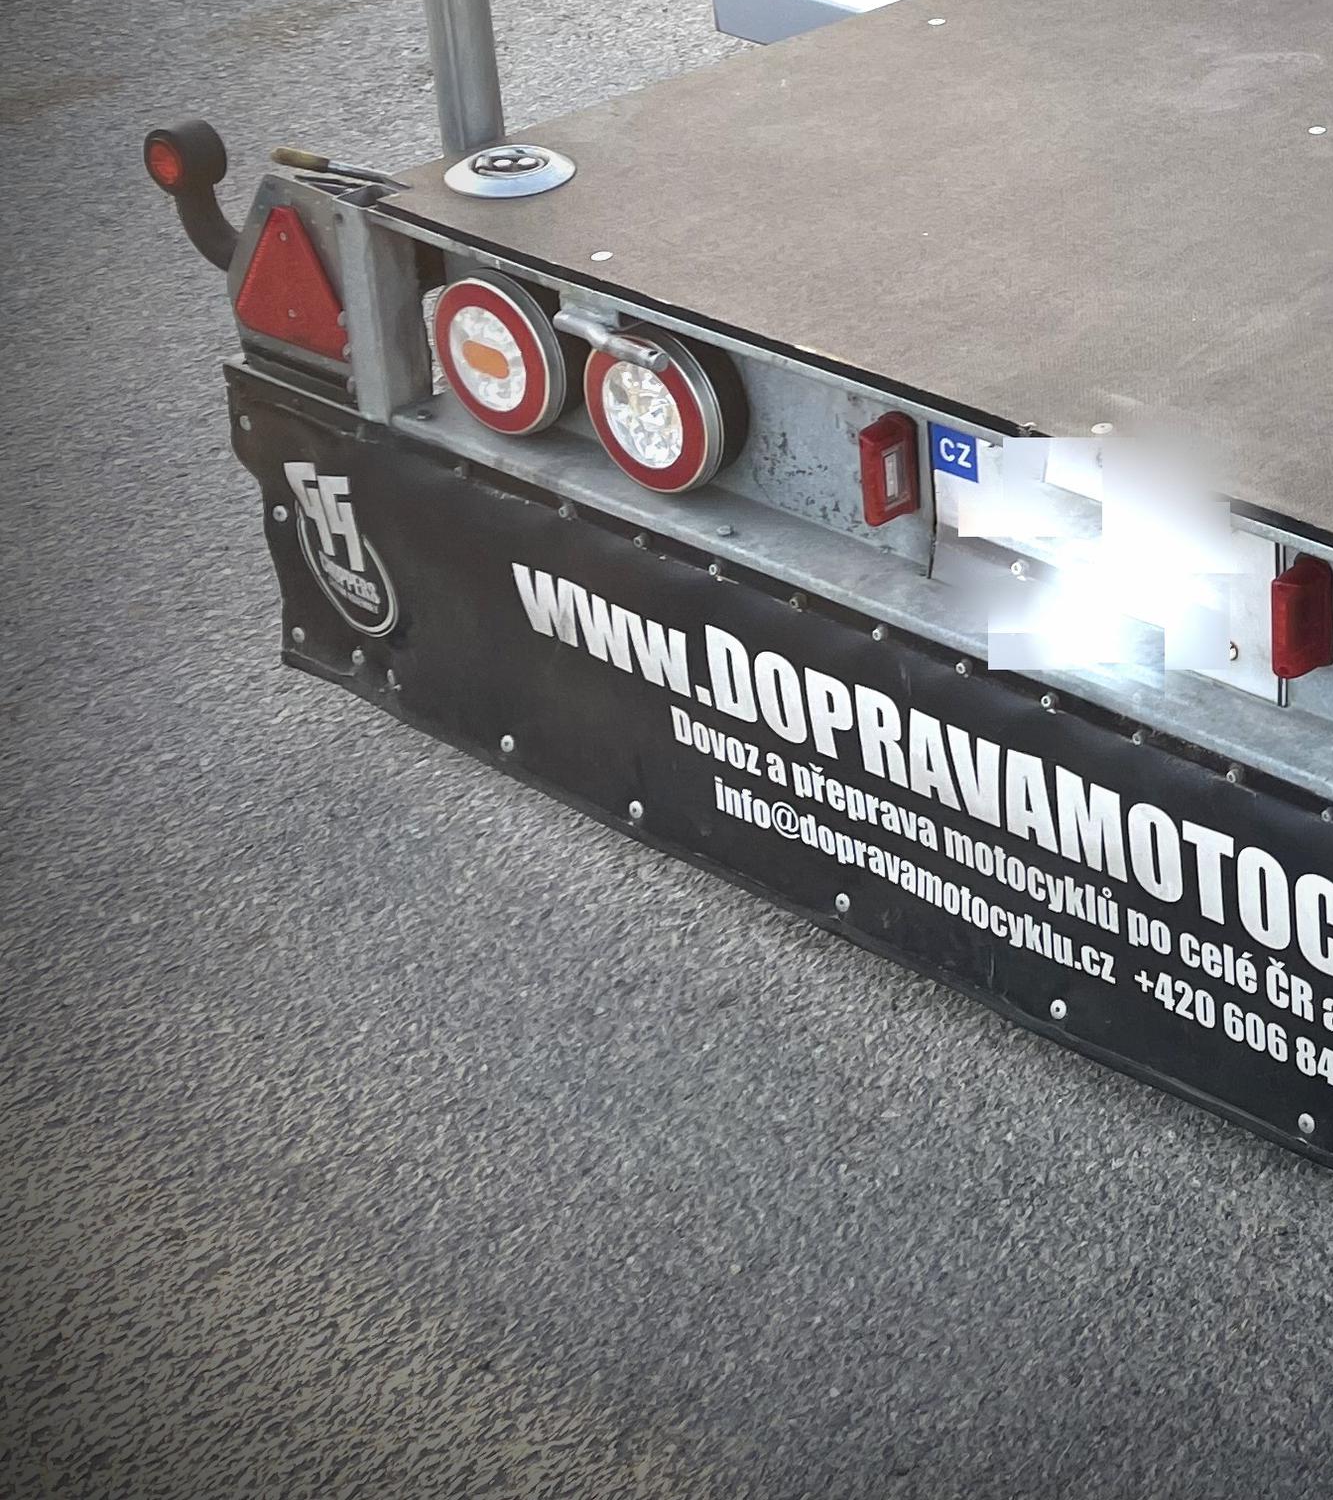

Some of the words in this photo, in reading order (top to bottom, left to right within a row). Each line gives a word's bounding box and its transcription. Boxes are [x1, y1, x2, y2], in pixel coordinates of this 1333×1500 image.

[939, 437, 973, 469] CZ
[669, 706, 761, 778] Dovoz
[767, 753, 786, 782] a
[793, 763, 938, 852] přeprava
[944, 831, 1119, 935] motocyklů
[1128, 907, 1171, 955] po
[1179, 934, 1258, 996] celé
[1266, 957, 1314, 1020] ČR
[714, 777, 1117, 985] info@dopravamotocyklu.cz
[1134, 967, 1214, 1029] +420
[1223, 1002, 1289, 1063] 606
